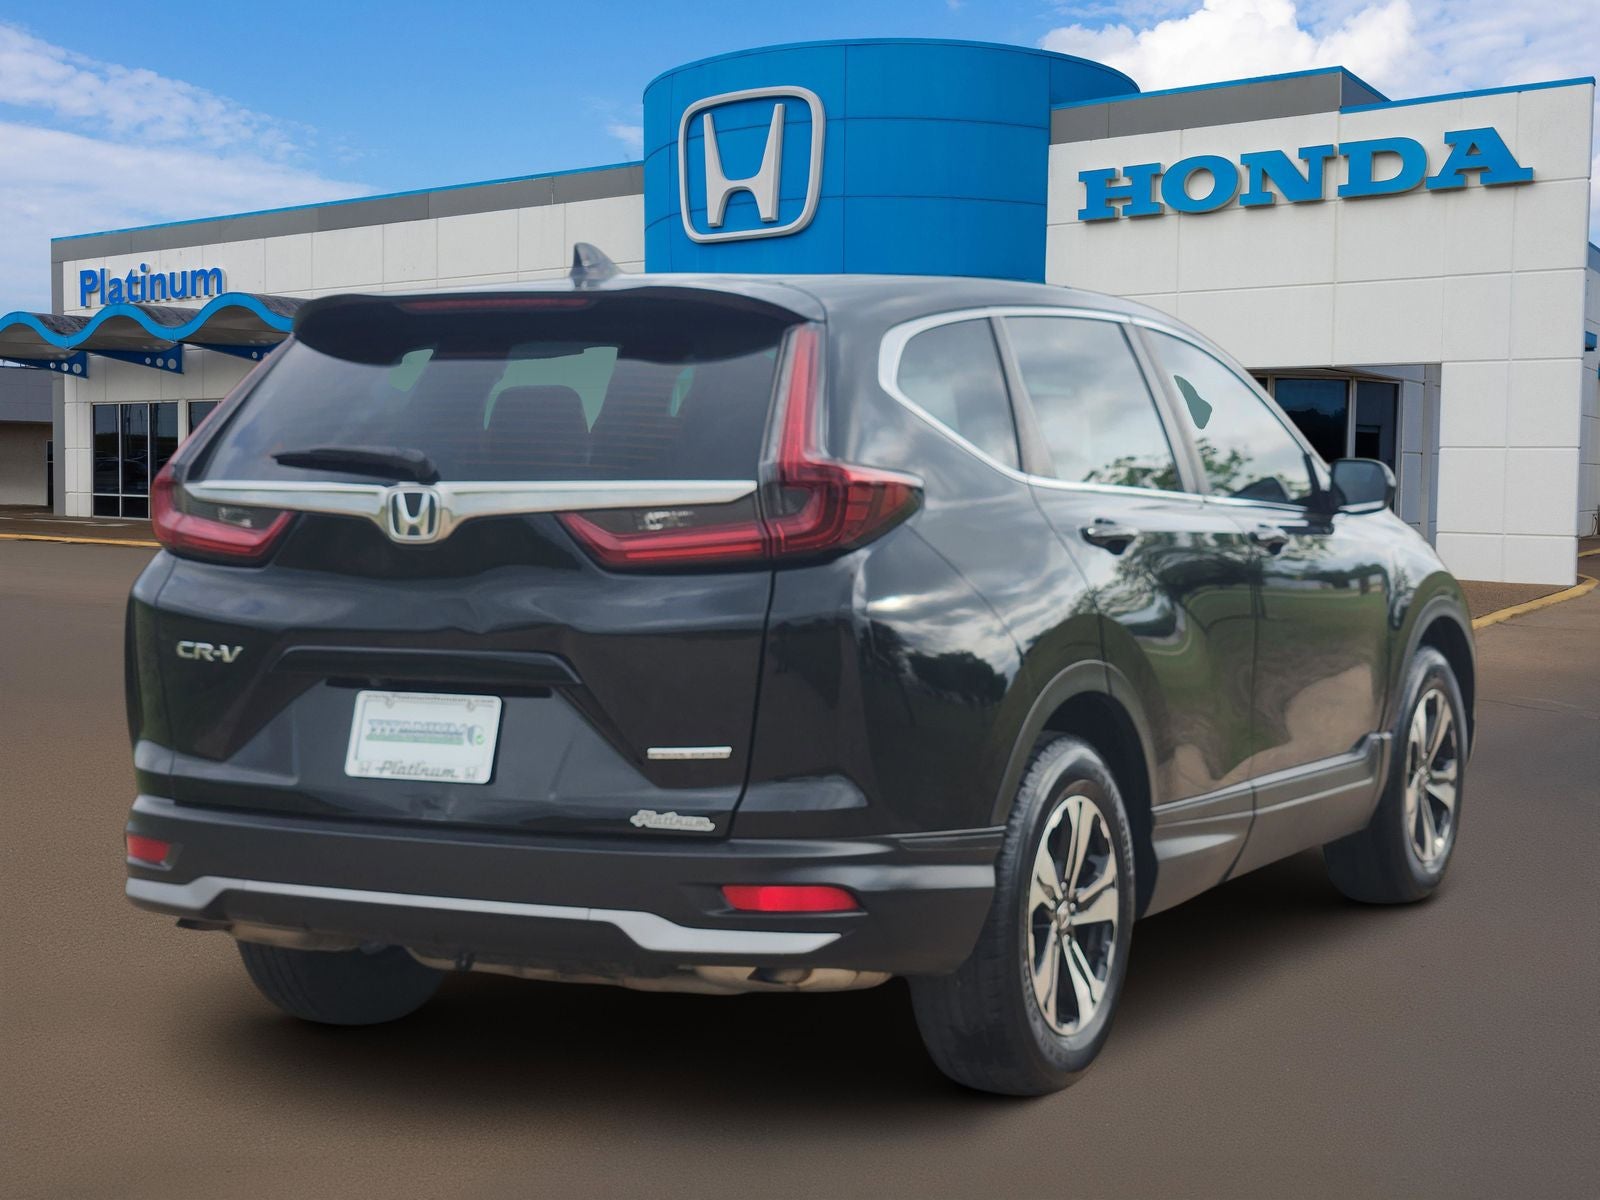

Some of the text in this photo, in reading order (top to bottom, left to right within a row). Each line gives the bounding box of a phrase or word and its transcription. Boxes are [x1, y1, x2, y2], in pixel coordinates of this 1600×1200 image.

[1078, 126, 1534, 221] HONDA
[79, 262, 227, 307] Platinum
[176, 640, 244, 663] CR-V
[376, 760, 461, 778] Platinum
